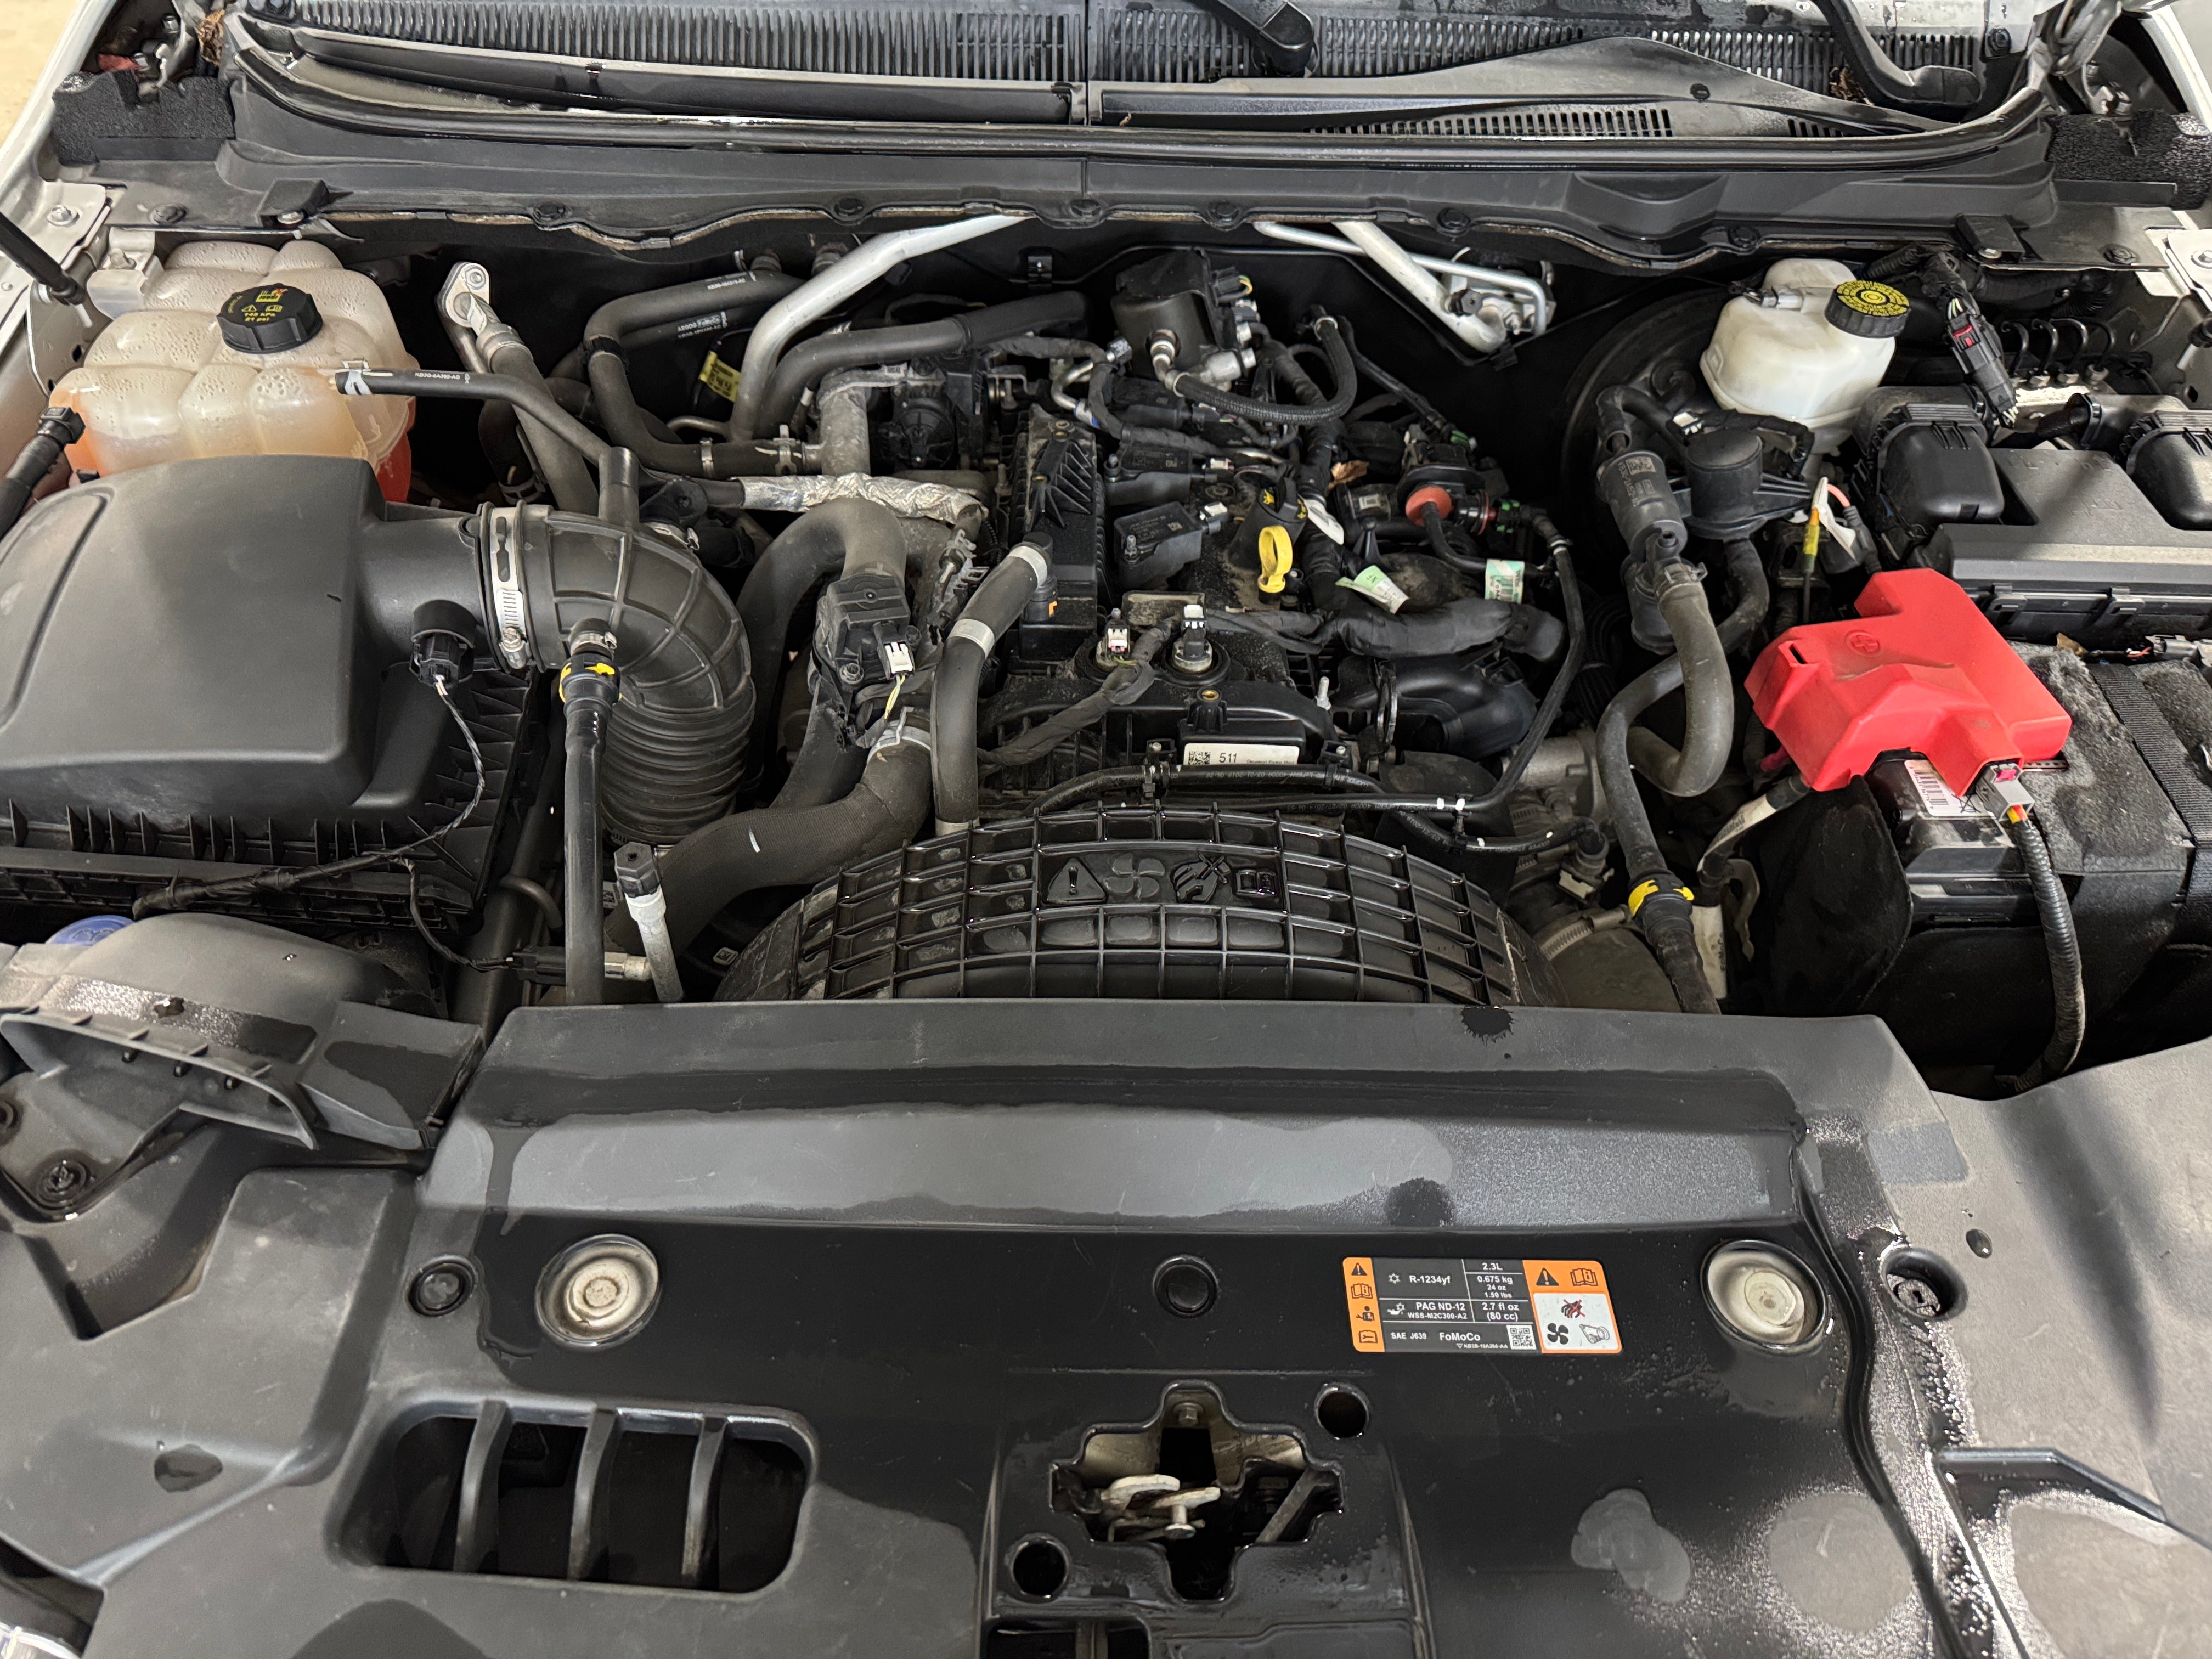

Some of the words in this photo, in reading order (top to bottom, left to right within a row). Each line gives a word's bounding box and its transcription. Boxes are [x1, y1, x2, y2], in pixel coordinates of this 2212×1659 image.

[1219, 753, 1237, 763] 511
[1482, 1262, 1503, 1271] 2.3L
[1409, 1275, 1451, 1285] R-1234yf
[1502, 1276, 1513, 1284] kg
[1415, 1302, 1436, 1311] PAG
[1437, 1302, 1466, 1311] ND-12
[1482, 1302, 1496, 1311] 2.7
[1498, 1302, 1505, 1311] fl
[1487, 1312, 1502, 1322] (80
[1504, 1312, 1519, 1322] cc)
[1439, 1332, 1481, 1341] FoMoCo
